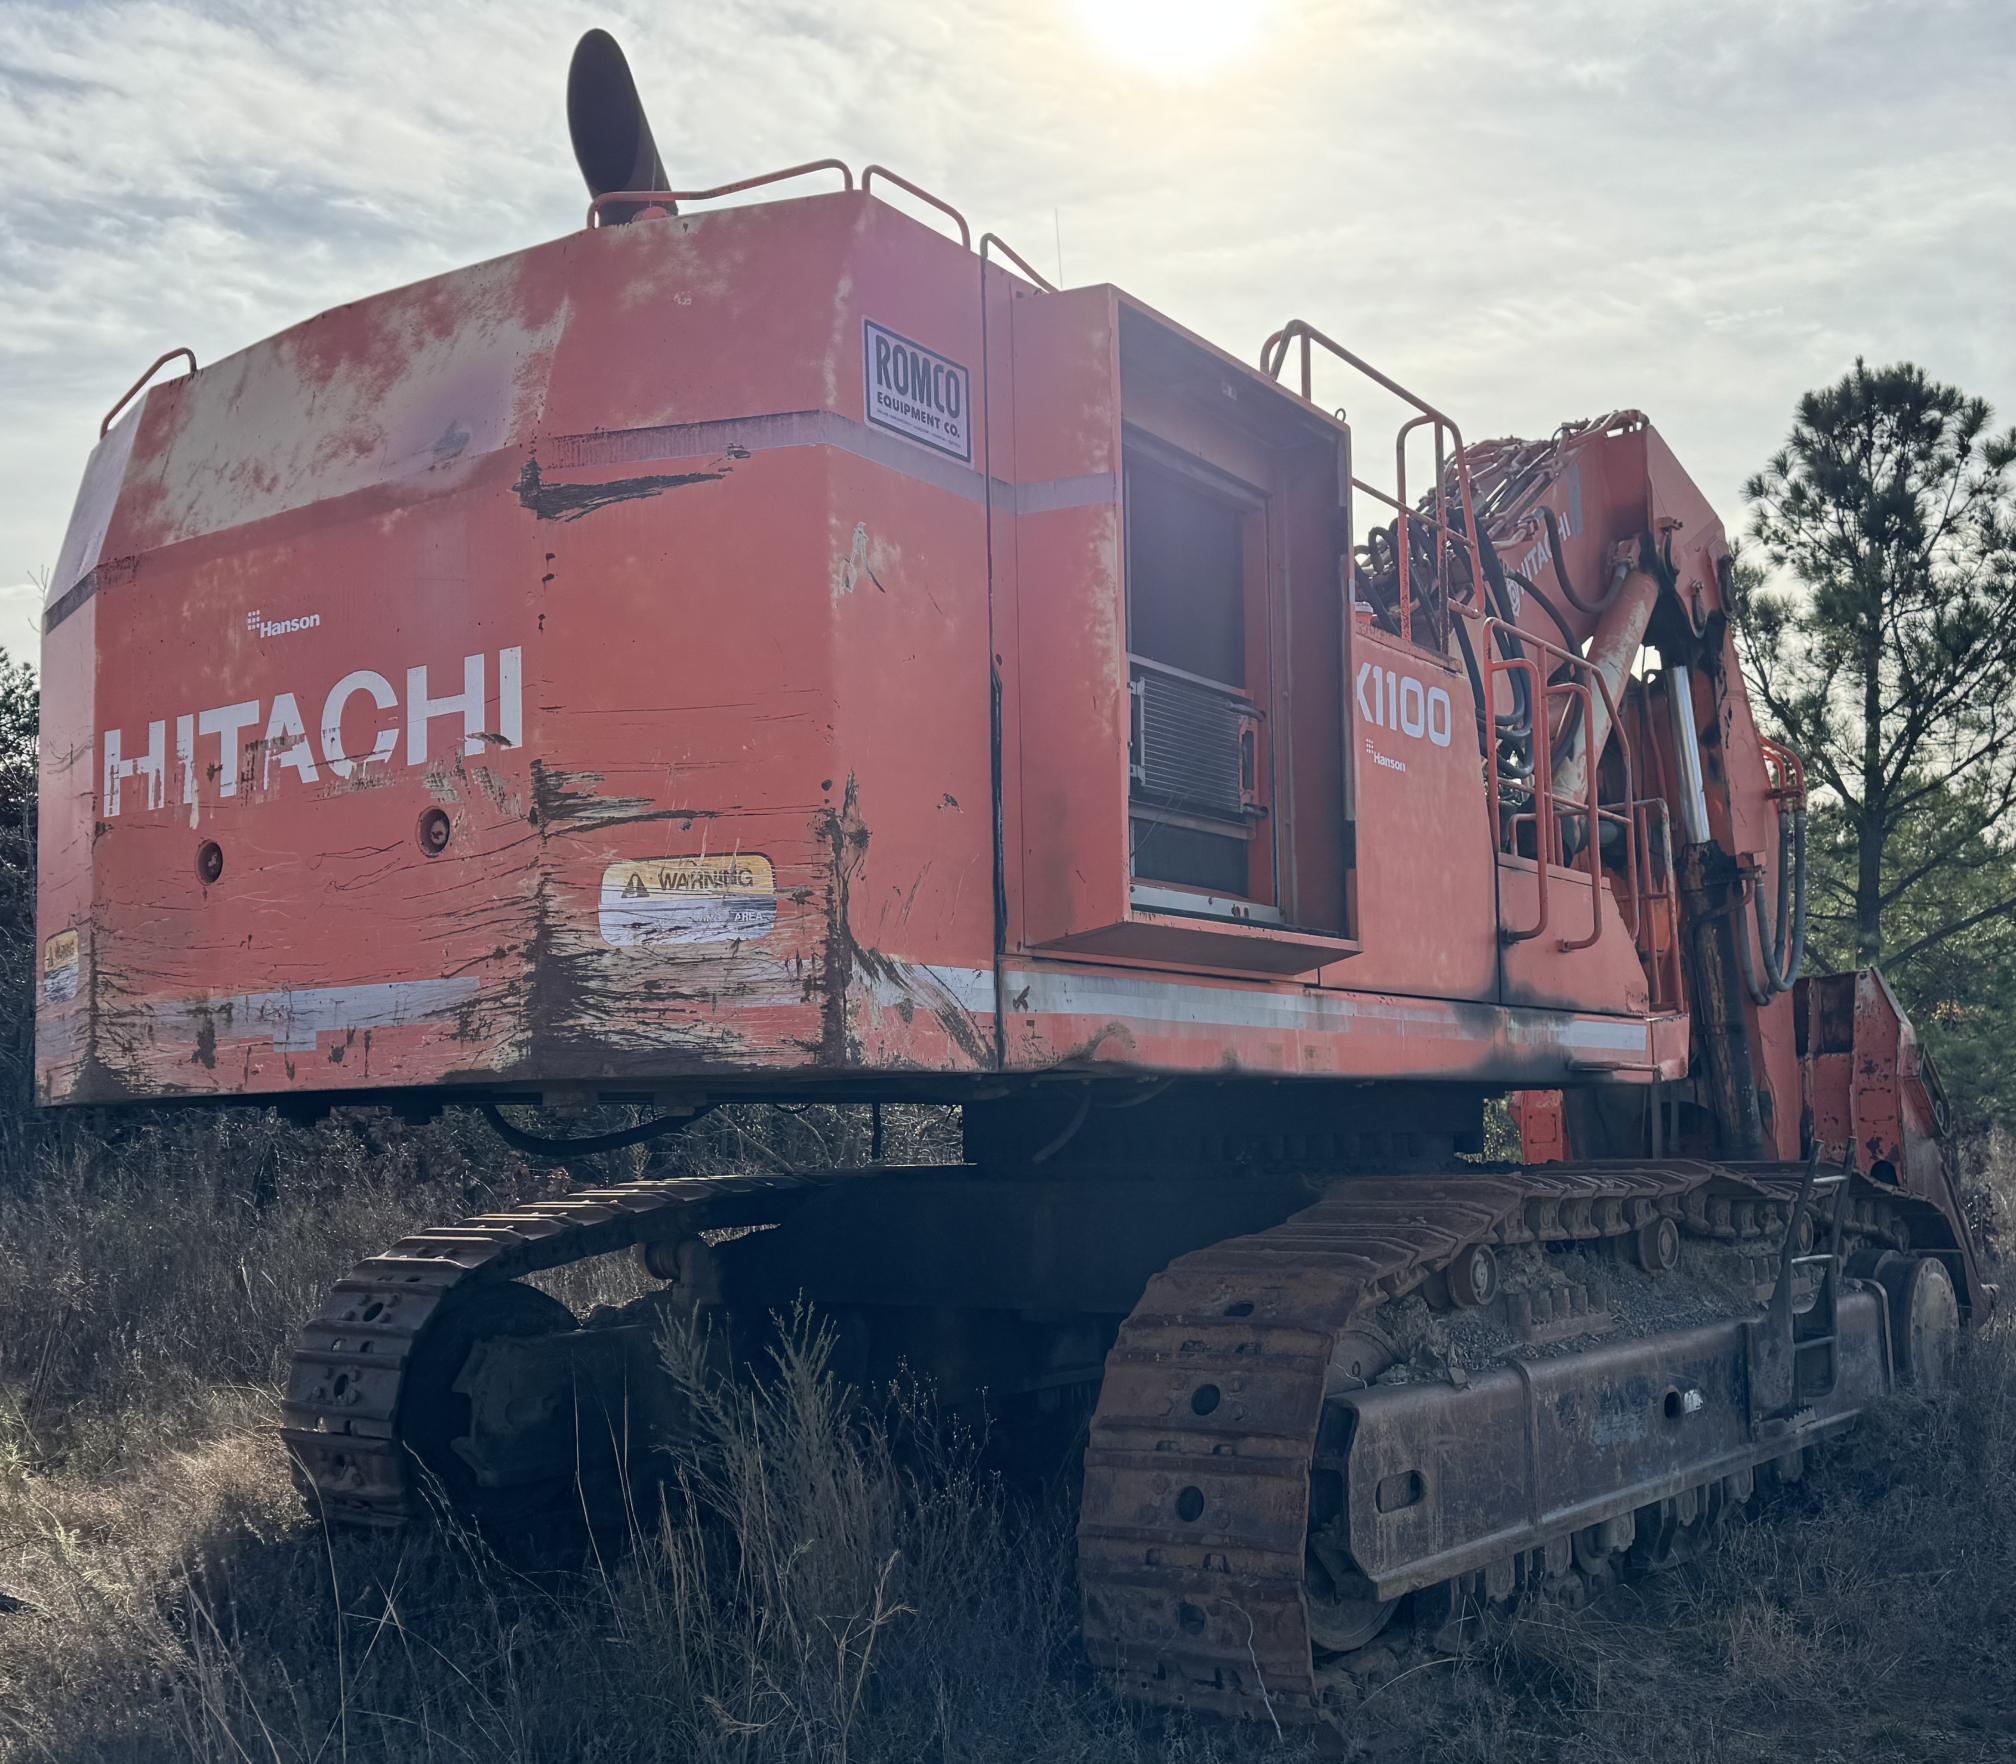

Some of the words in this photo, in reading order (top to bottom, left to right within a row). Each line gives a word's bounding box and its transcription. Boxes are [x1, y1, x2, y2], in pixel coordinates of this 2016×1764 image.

[876, 335, 960, 418] ROMCO
[877, 392, 941, 429] EQUIPMENT
[944, 421, 960, 438] CO.
[260, 613, 320, 638] Hanson
[104, 646, 522, 817] HITACHI
[1373, 752, 1405, 772] Hanson
[657, 868, 754, 890] WARNING
[734, 911, 763, 922] AREA
